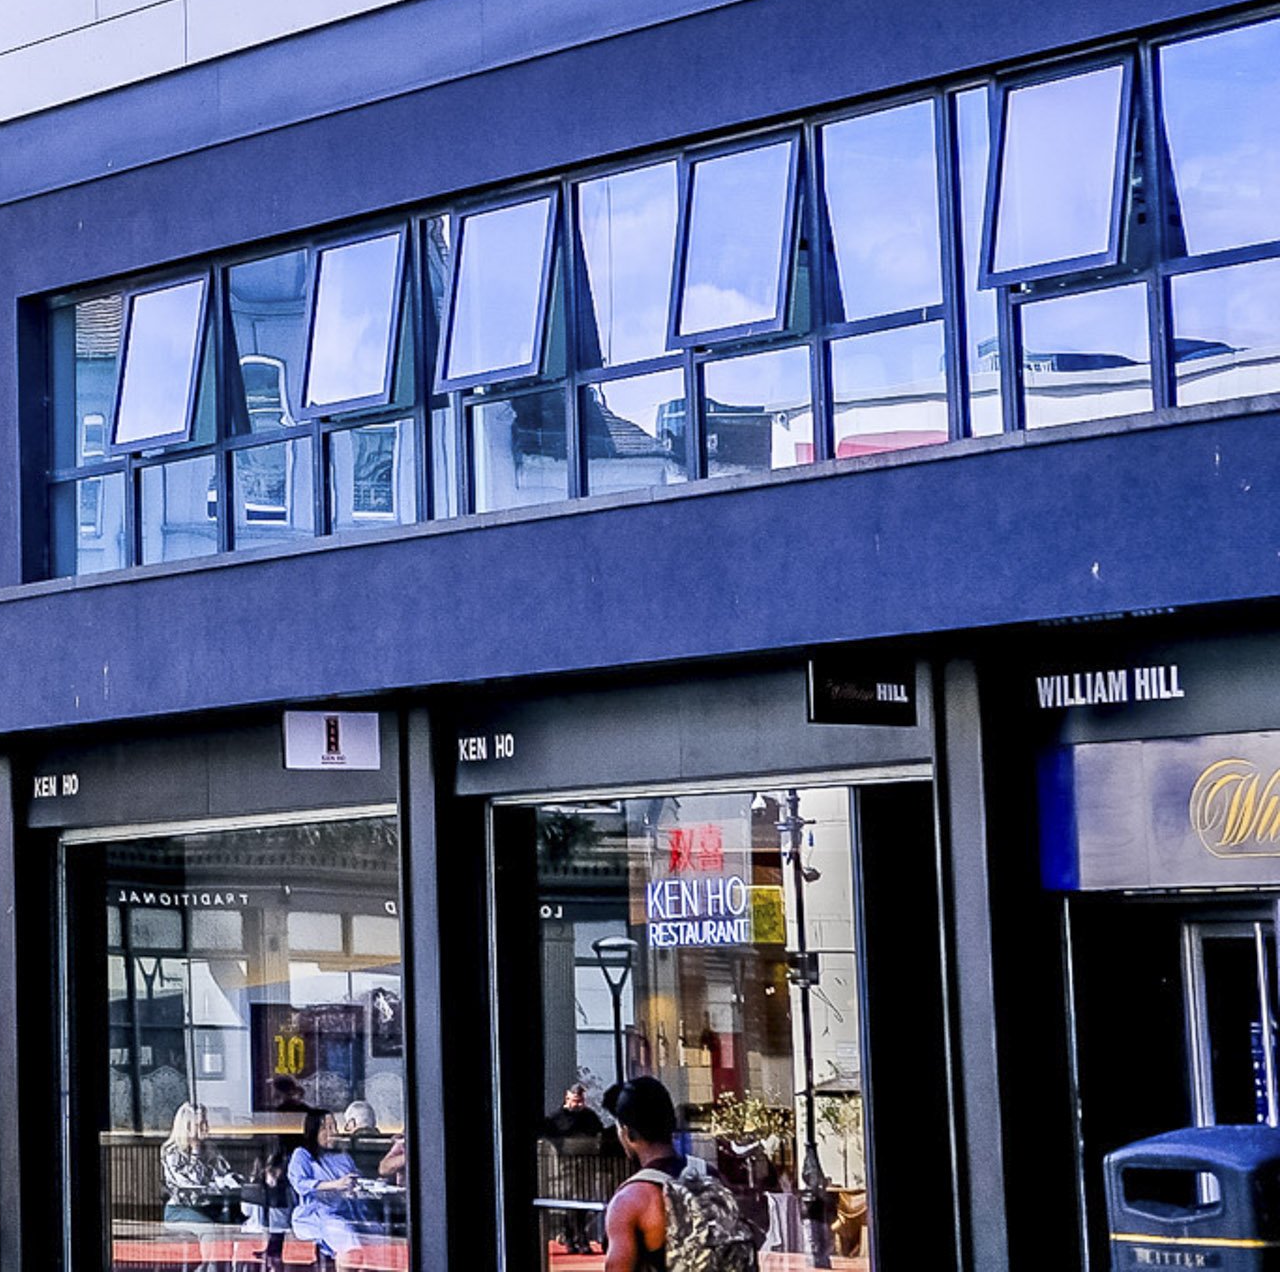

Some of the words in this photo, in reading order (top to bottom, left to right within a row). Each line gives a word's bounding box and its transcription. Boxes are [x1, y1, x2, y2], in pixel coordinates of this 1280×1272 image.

[876, 682, 909, 703] HILL
[1037, 669, 1128, 708] WILLIAM
[1135, 665, 1185, 701] HILL
[458, 736, 488, 761] KEN
[495, 733, 515, 759] HO
[34, 776, 57, 798] KEN
[62, 773, 79, 796] HO
[647, 879, 700, 919] KEN
[706, 876, 747, 917] HO
[649, 919, 750, 947] RESTAURANT
[273, 1034, 305, 1075] 10
